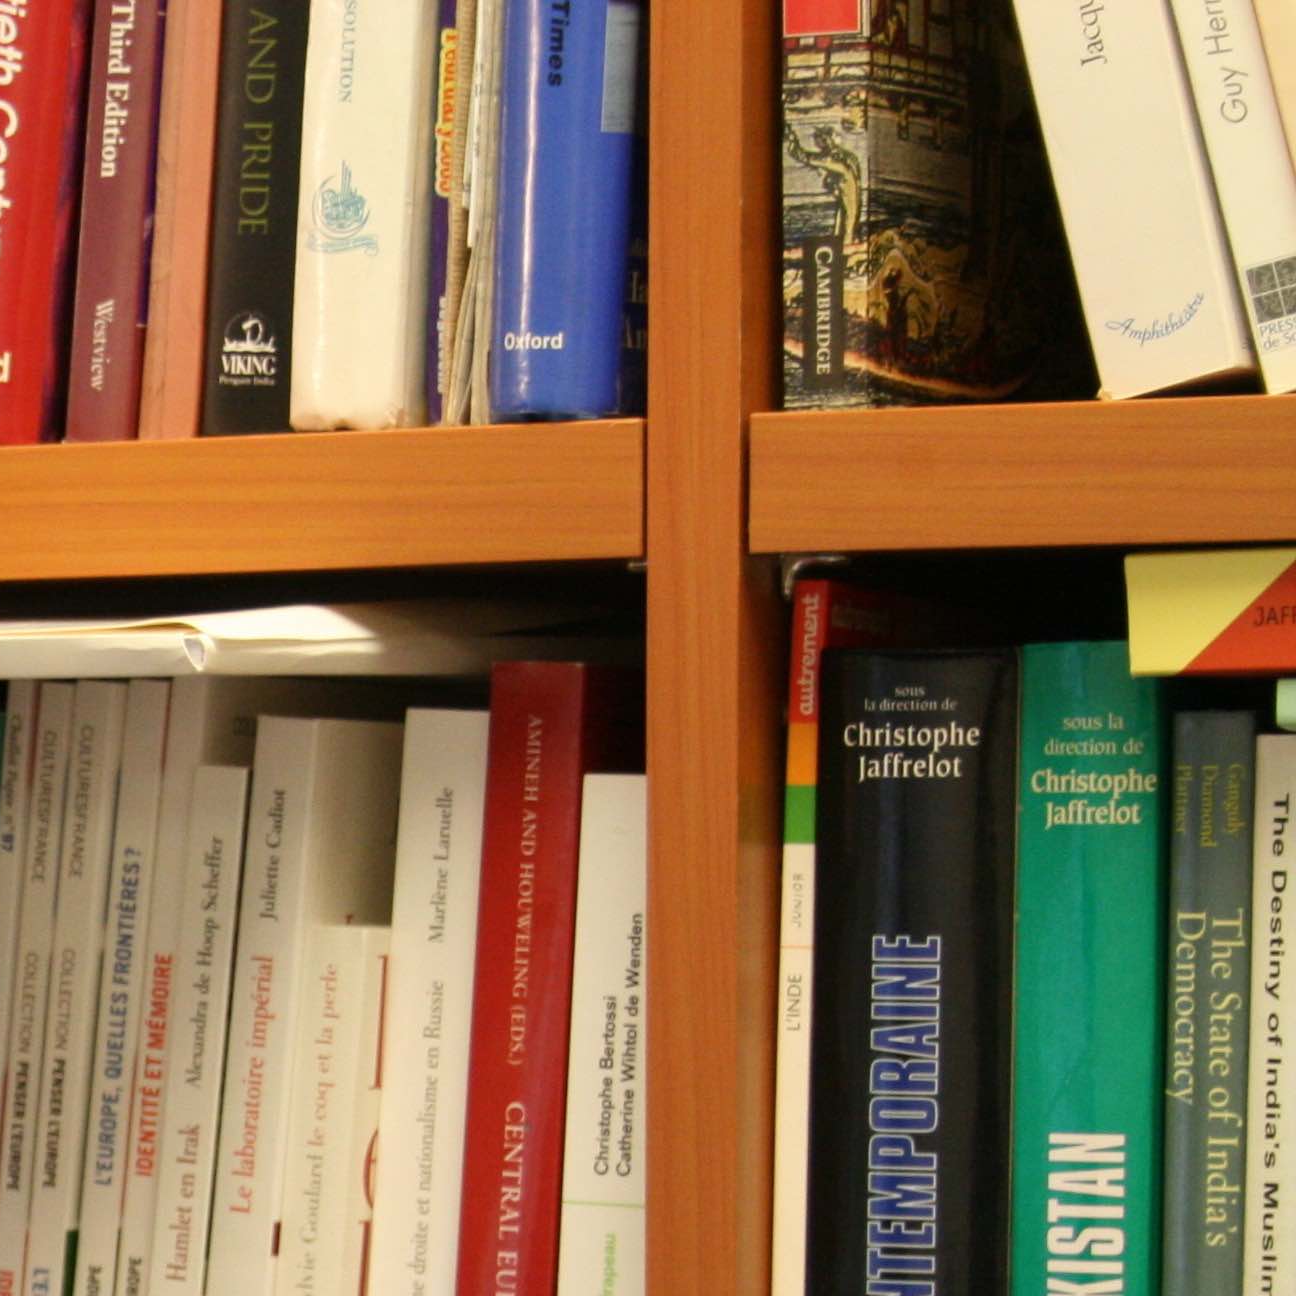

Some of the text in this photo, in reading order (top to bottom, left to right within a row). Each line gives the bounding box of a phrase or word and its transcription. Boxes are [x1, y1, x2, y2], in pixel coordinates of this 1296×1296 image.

[100, 0, 136, 178] Third Edition
[337, 0, 359, 104] SOLUTION
[547, 0, 571, 88] Times
[1219, 66, 1250, 124] Guy
[236, 8, 281, 237] AND PRIDE
[89, 298, 115, 392] Westview
[221, 354, 277, 376] VIKING
[504, 331, 564, 351] Oxford
[813, 245, 834, 377] CAMBRIDGE
[799, 592, 821, 716] autrement
[878, 697, 938, 712] direction
[842, 722, 981, 756] Christophe
[858, 751, 963, 782] Jaffrelot
[1043, 736, 1145, 757] direction de
[1062, 712, 1125, 731] sous la
[30, 728, 57, 884] CULTURESFRANCE
[66, 723, 95, 881] CULTURESFRANCE
[1030, 767, 1158, 800] Christophe
[1044, 799, 1142, 831] Jaffrelot
[1199, 764, 1220, 848] Diamond
[1271, 792, 1290, 857] The
[258, 788, 288, 922] Juliette Cadiot
[427, 785, 455, 946] Marlène Laruelle
[511, 712, 544, 1001] AMINEH AND HOUWELING
[103, 863, 140, 1079] QUELLES FRONTIÈRES
[1264, 870, 1288, 1002] Destiny
[13, 951, 39, 1120] COLLECTION PENSER
[50, 947, 78, 1119] COLLECTION PENSER
[423, 978, 445, 1040] Russie
[614, 911, 644, 1178] Catherine de Wenden
[785, 972, 804, 1033] L'INDE
[1165, 911, 1207, 1107] Democracy
[1264, 1011, 1283, 1049] of
[135, 951, 175, 1178] IDENTITÉ ET MÉMOIRE
[228, 953, 276, 1215] Le laboratoire impérial
[592, 994, 618, 1177] Christophe Bertossi
[1204, 907, 1247, 1249] The State of India's
[1262, 1055, 1281, 1169] India's
[419, 1074, 440, 1193] nationalisme
[494, 1101, 527, 1243] CENTRAL
[164, 1123, 201, 1284] Hamlet en Irak
[411, 1220, 430, 1274] droite
